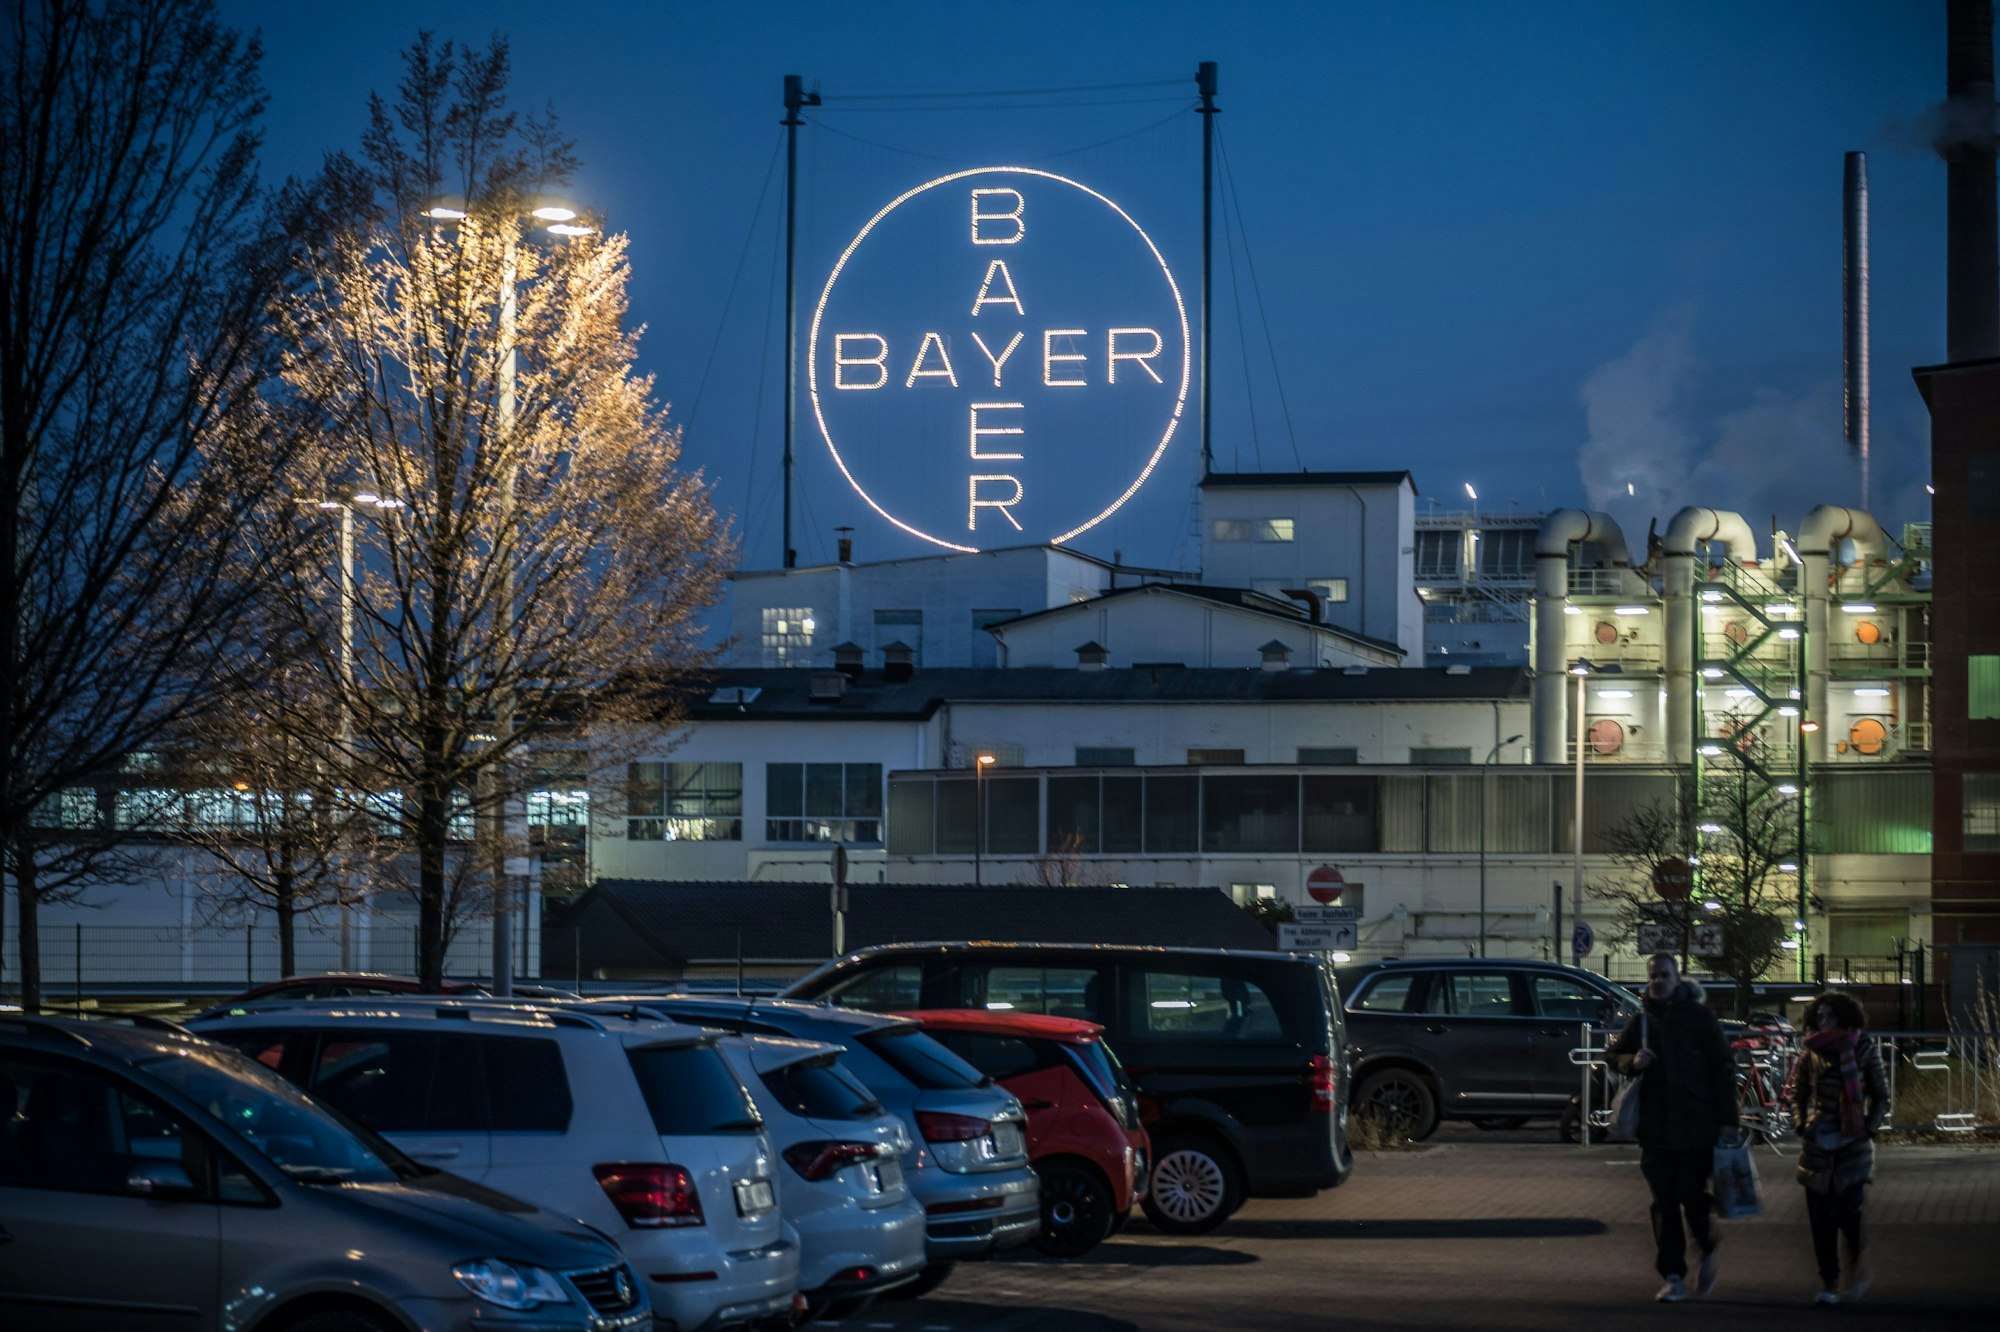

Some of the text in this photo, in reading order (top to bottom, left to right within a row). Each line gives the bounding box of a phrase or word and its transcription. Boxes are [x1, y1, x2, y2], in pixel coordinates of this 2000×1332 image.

[833, 327, 1164, 390] BAYER
[969, 187, 1026, 531] BAYER
[1321, 909, 1353, 918] Ausfahrt
